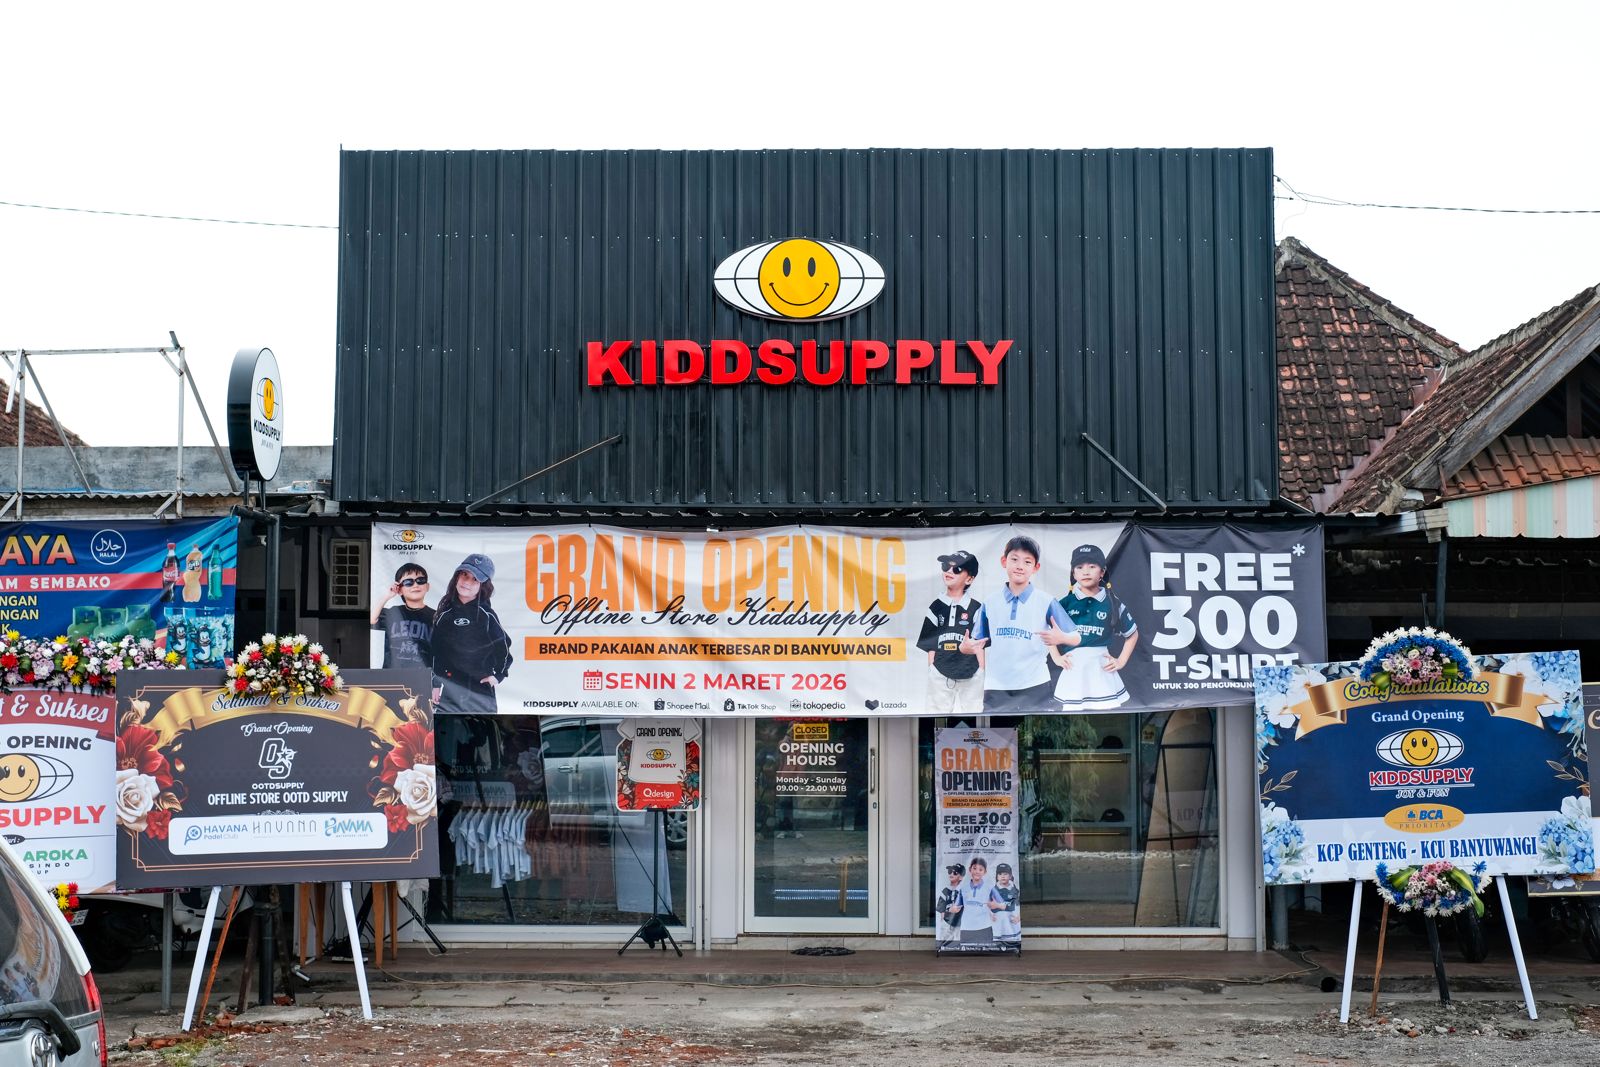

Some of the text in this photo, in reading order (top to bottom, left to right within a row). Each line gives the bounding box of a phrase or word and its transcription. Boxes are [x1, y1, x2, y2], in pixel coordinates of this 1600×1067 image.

[587, 340, 1014, 386] KIDDSUPPLY
[253, 419, 281, 442] KIDDSUPPLY
[1, 534, 76, 566] AYA
[525, 533, 906, 614] GRAND OPENING
[30, 576, 111, 589] SEMBAKO
[0, 609, 39, 620] NGAN
[540, 594, 890, 635] Offline Store Kiddsupply
[1152, 595, 1297, 649] 300
[539, 643, 891, 656] BRAND PAKAIAN ANAK TERBESAR DI BANYUWANGI
[606, 673, 847, 690] SENIN 2 MARET 2026
[11, 695, 28, 716] &
[36, 694, 109, 722] Sukses
[212, 693, 341, 711] Selamat & Sukses
[666, 702, 693, 711] Shopee
[803, 702, 846, 711] tokopedia
[1371, 709, 1464, 723] Grand Opening
[241, 722, 313, 737] Grand Opening
[637, 728, 682, 737] GRAND OPENING
[7, 735, 92, 750] OPENING
[780, 743, 844, 753] OPENING
[787, 755, 836, 766] HOURS
[941, 748, 1011, 770] GRAND
[941, 771, 1011, 791] OPENING
[1369, 768, 1474, 786] KIDDSUPPLY
[252, 782, 305, 790] OOTDSUPPLY
[643, 788, 675, 798] Qdesign
[208, 791, 348, 806] OFFLINE STORE OOTD SUPPLY
[1395, 788, 1450, 799] JOY & FUN
[0, 805, 106, 828] SUPPLY
[944, 815, 976, 824] FREE
[1419, 809, 1444, 820] BCA
[204, 825, 248, 833] HAVANA
[252, 820, 317, 834] HAVANA
[325, 817, 373, 837] HAVANA
[944, 825, 987, 834] T-SHIRT
[1399, 822, 1452, 830] PRIORITAS
[23, 849, 88, 861] AROKA
[1317, 844, 1344, 862] KCP
[1349, 842, 1407, 861] GENTENG
[1421, 840, 1445, 859] KCU
[1449, 836, 1538, 858] BANYUWANGI
